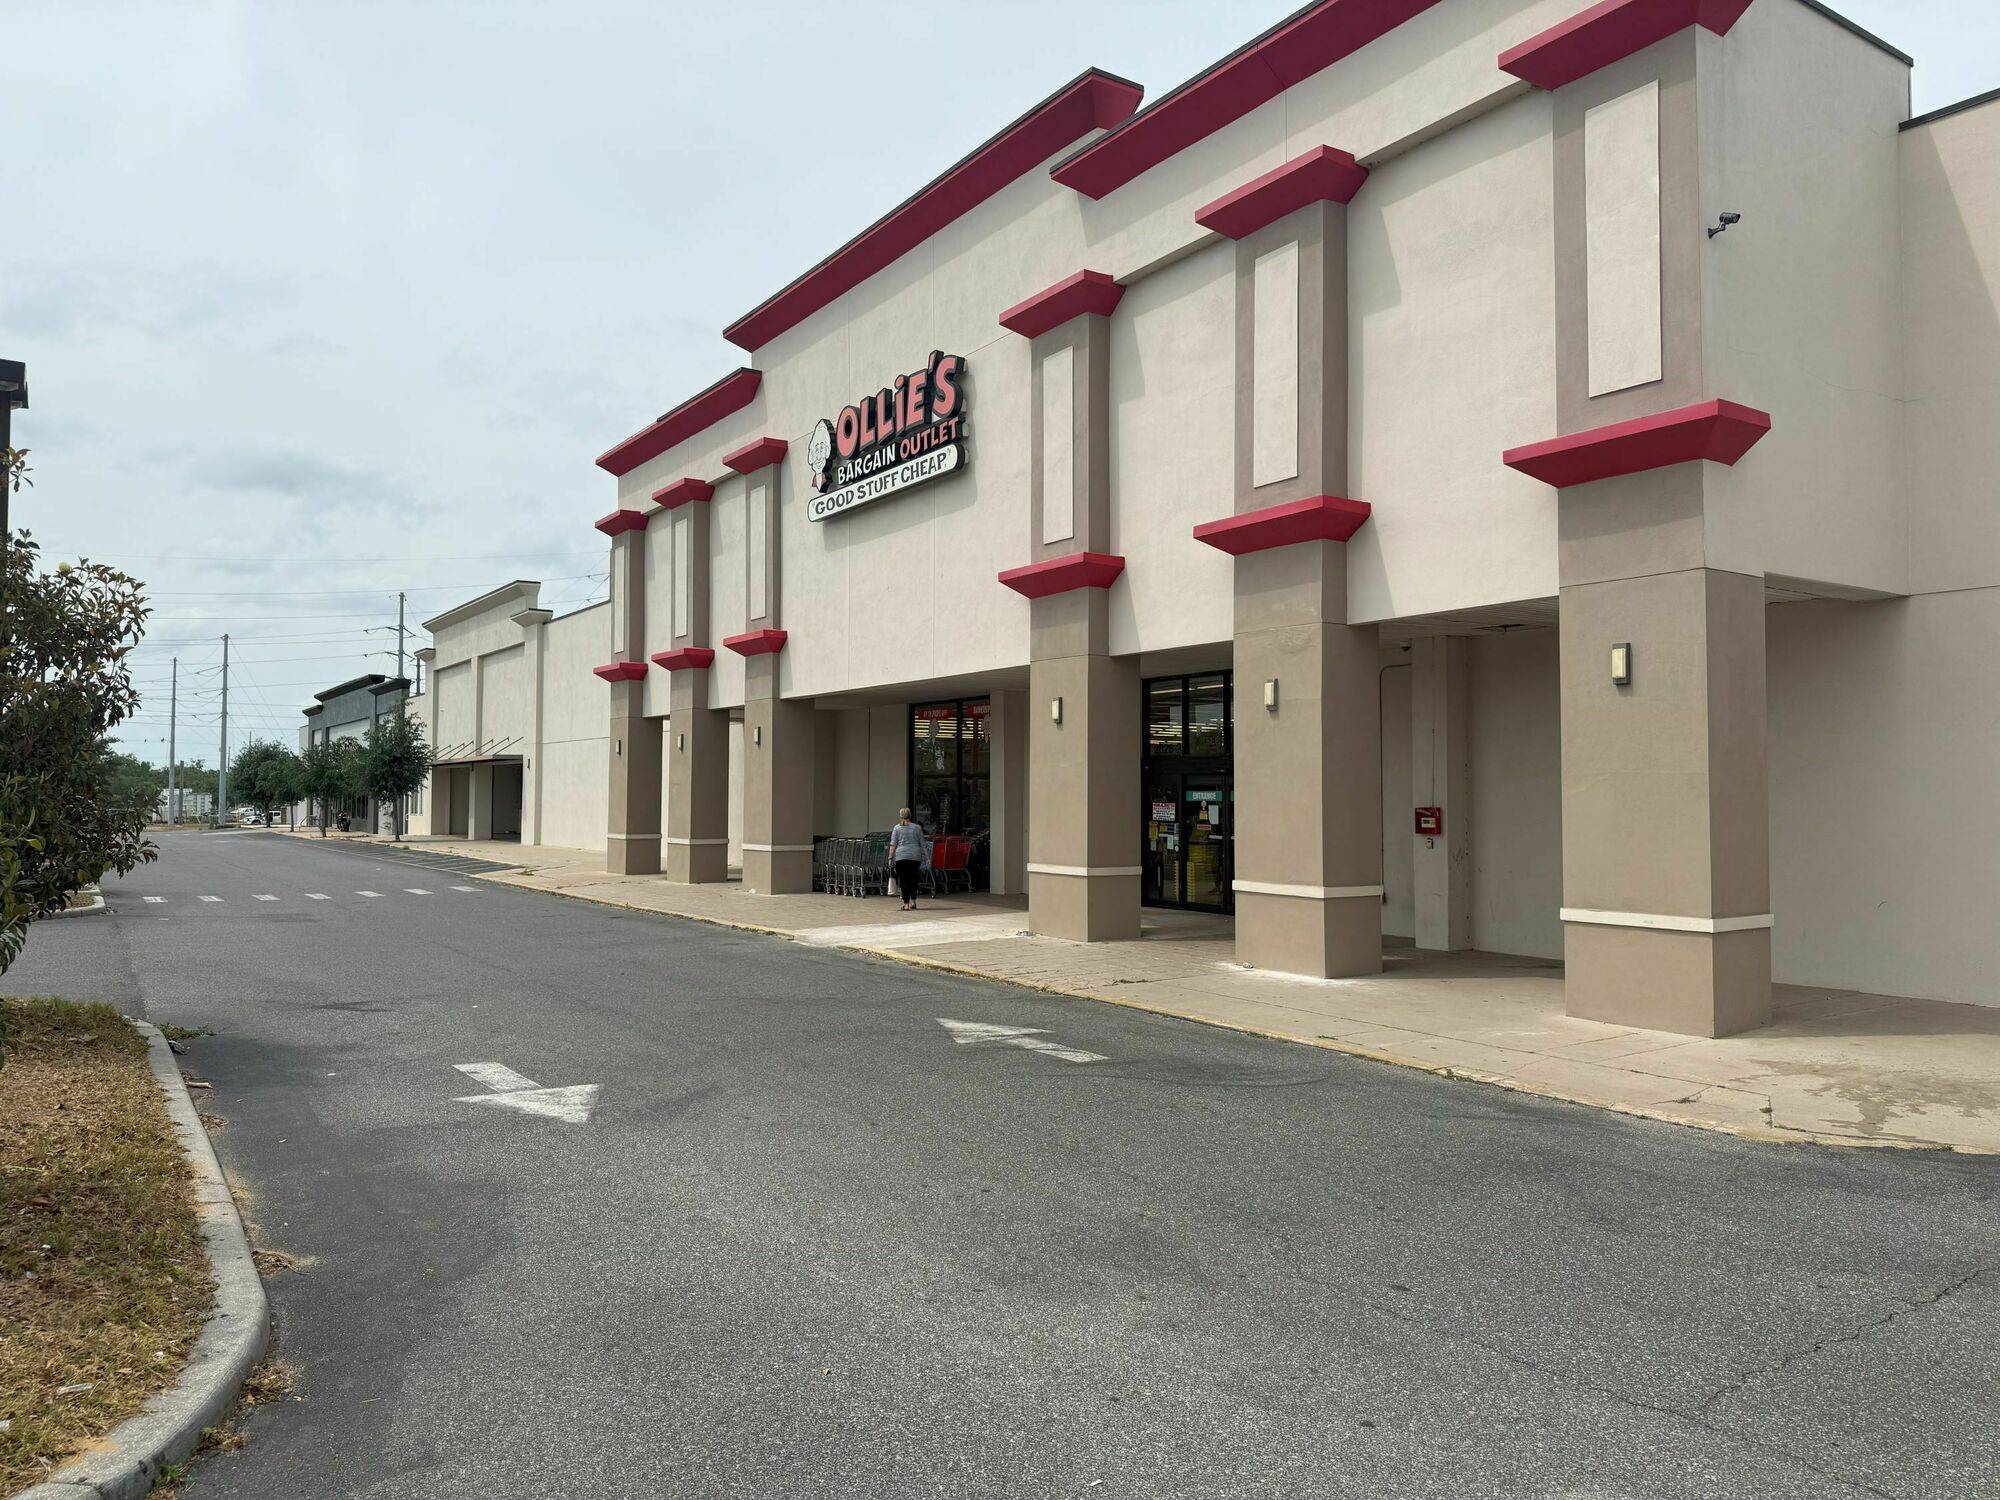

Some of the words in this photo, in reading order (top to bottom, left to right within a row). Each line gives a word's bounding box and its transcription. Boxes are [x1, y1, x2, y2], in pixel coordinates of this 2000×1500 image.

[837, 443, 896, 485] BARGAIN
[900, 416, 960, 460] OUTLET
[857, 471, 899, 500] STUFF
